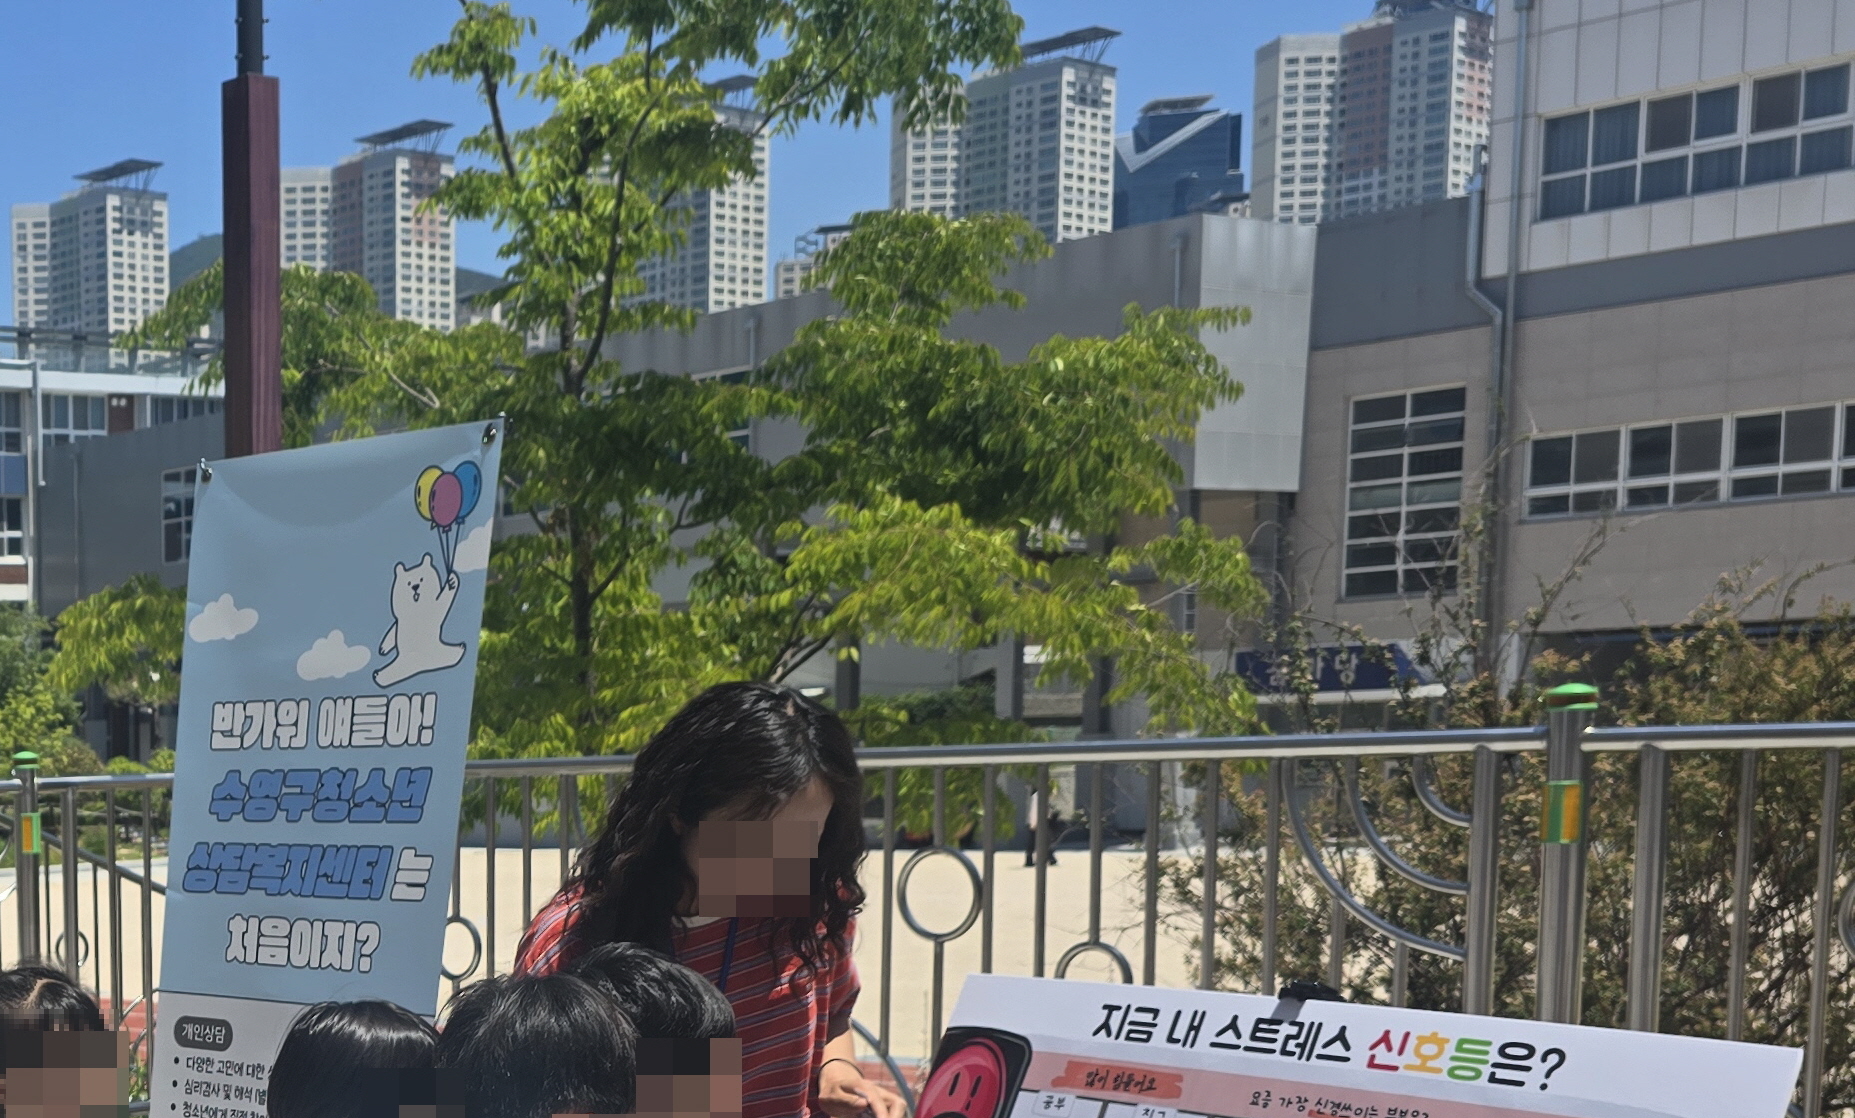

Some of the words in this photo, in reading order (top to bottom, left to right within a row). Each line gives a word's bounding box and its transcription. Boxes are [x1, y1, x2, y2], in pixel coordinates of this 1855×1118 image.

[210, 698, 308, 750] 반가워
[209, 767, 433, 823] 수영구청소년
[183, 842, 393, 900] 상담복지센터
[225, 914, 380, 972] 처음이지?
[182, 1023, 225, 1044] 개인상담
[1092, 1003, 1160, 1043] 지금
[1166, 1010, 1206, 1048] 내
[1209, 1014, 1352, 1063] 스트레스
[1366, 1029, 1567, 1090] 신호등은?
[186, 1056, 215, 1074] 다양한
[216, 1060, 244, 1077] 고민에
[246, 1063, 265, 1080] 대한
[184, 1079, 220, 1097] 심리검사
[223, 1083, 232, 1100] 및
[1042, 1095, 1066, 1110] 공부
[1249, 1090, 1272, 1109] 요즘
[1280, 1095, 1310, 1113] 가장
